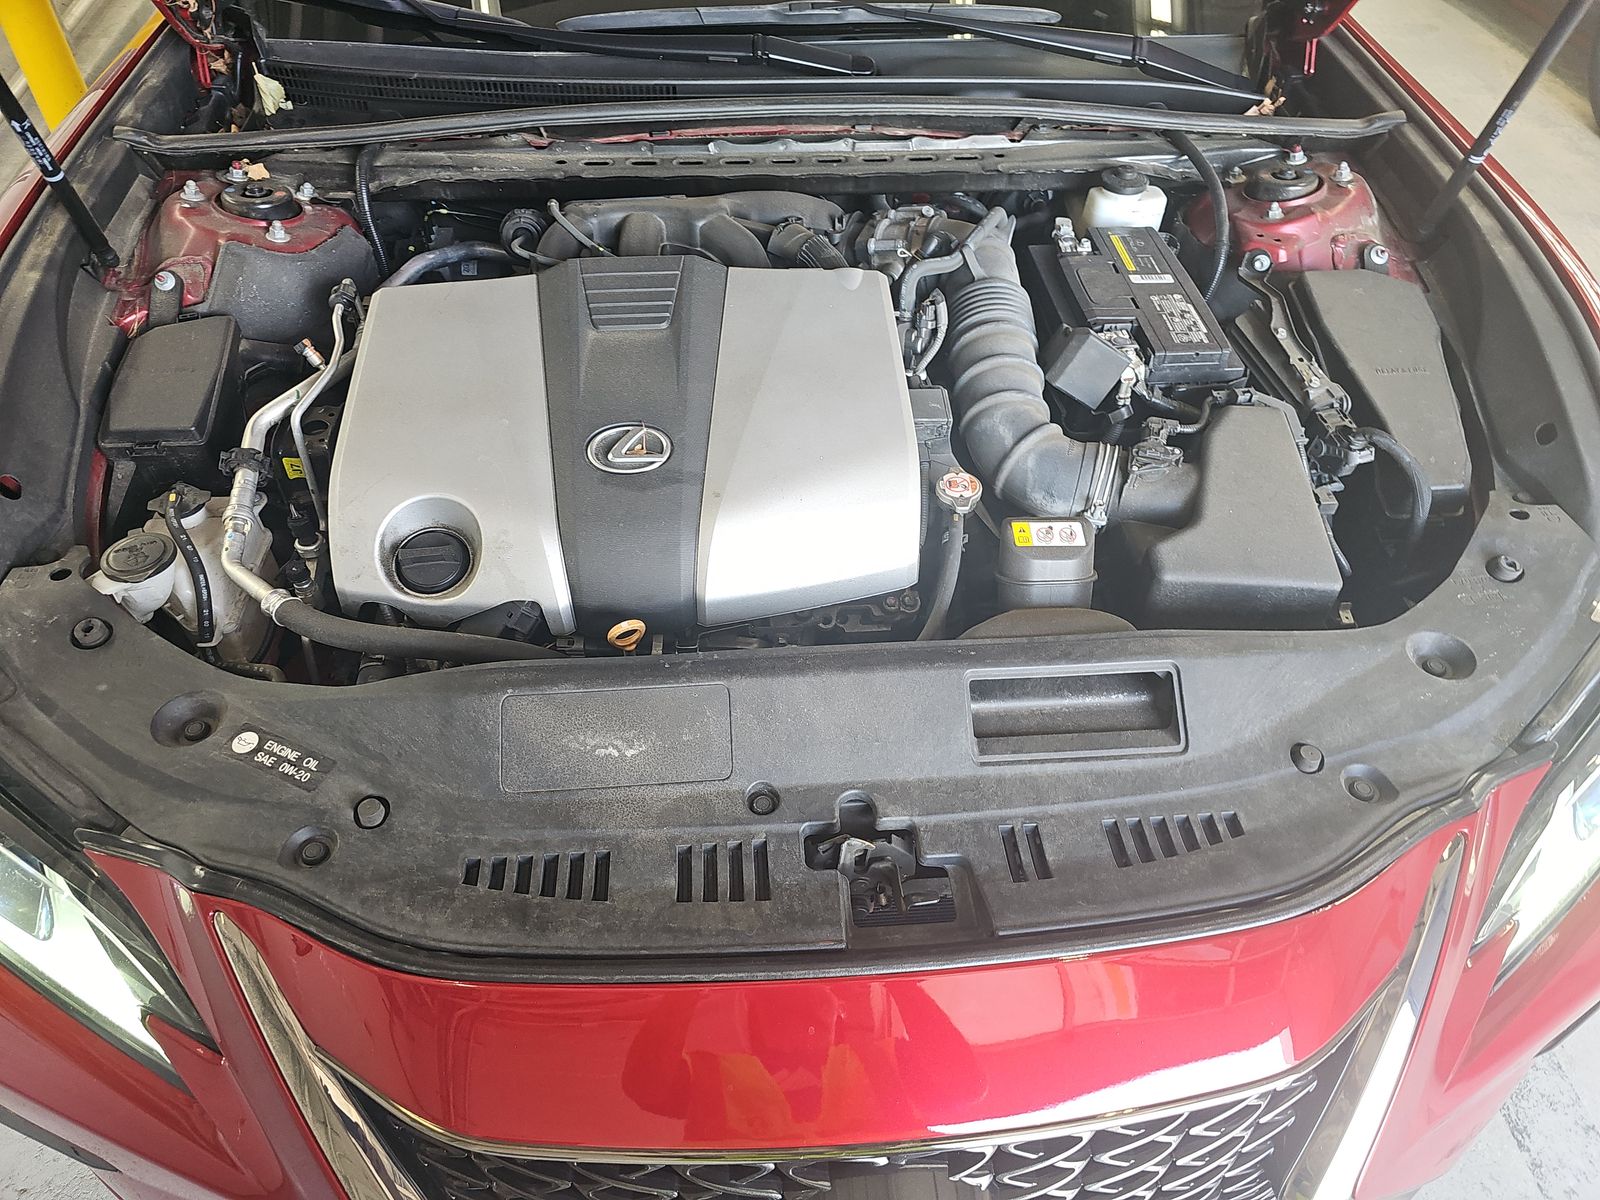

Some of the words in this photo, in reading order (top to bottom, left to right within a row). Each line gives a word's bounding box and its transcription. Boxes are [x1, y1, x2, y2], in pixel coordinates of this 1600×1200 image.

[254, 752, 277, 767] SAE
[279, 762, 311, 782] 0W-20
[264, 740, 301, 762] ENGINE
[303, 757, 319, 771] OIL
